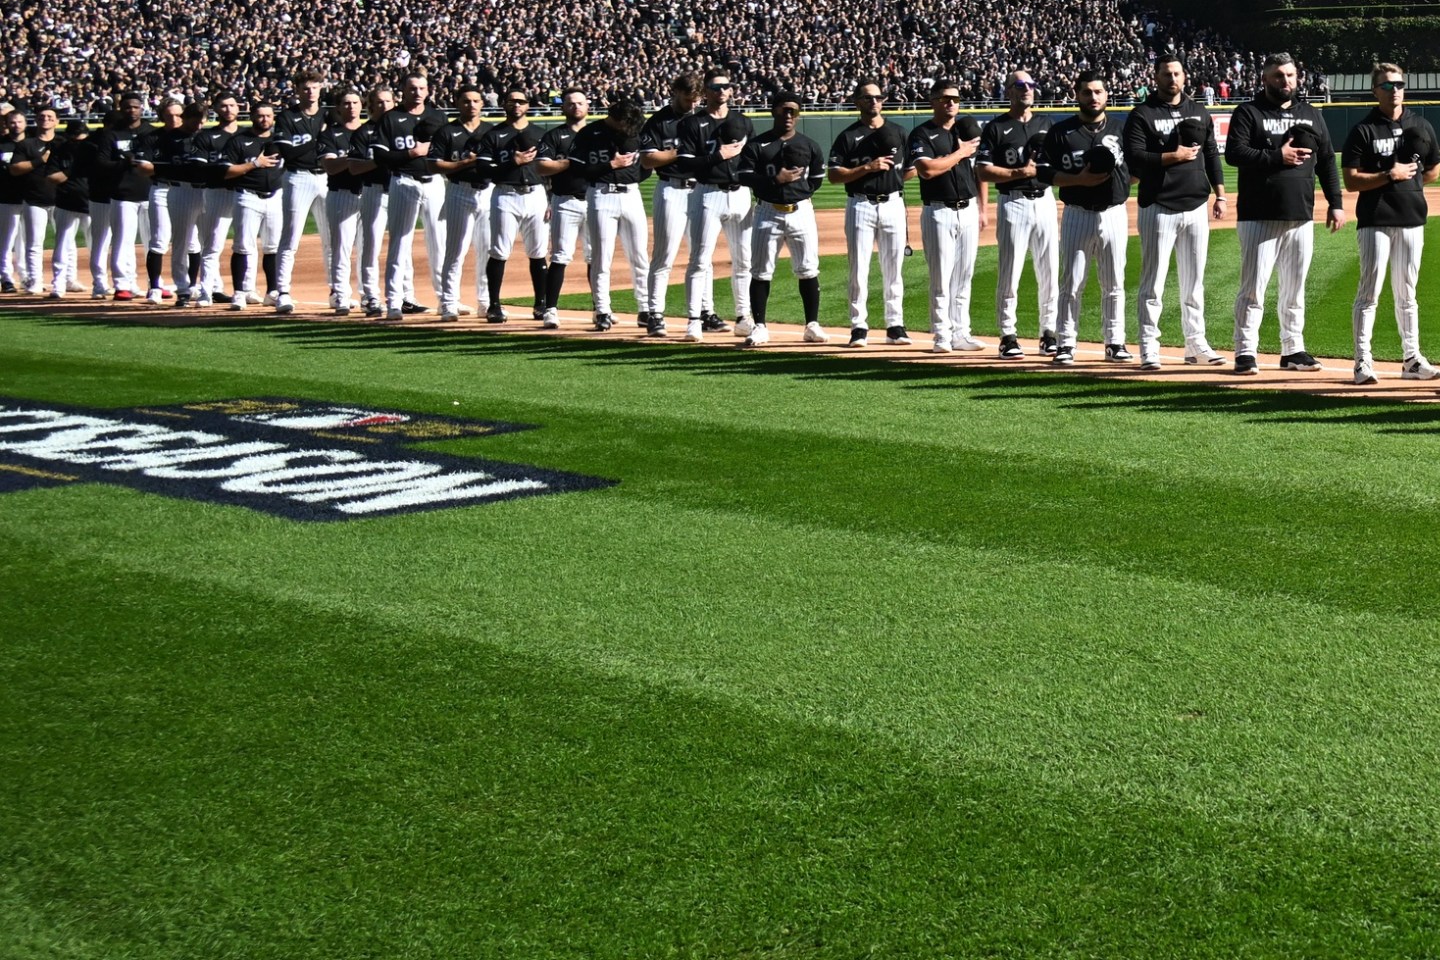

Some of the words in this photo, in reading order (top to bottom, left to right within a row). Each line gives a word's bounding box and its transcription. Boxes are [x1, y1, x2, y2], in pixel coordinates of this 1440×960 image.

[393, 135, 416, 150] 60
[588, 149, 611, 165] 65
[1062, 150, 1085, 170] 95
